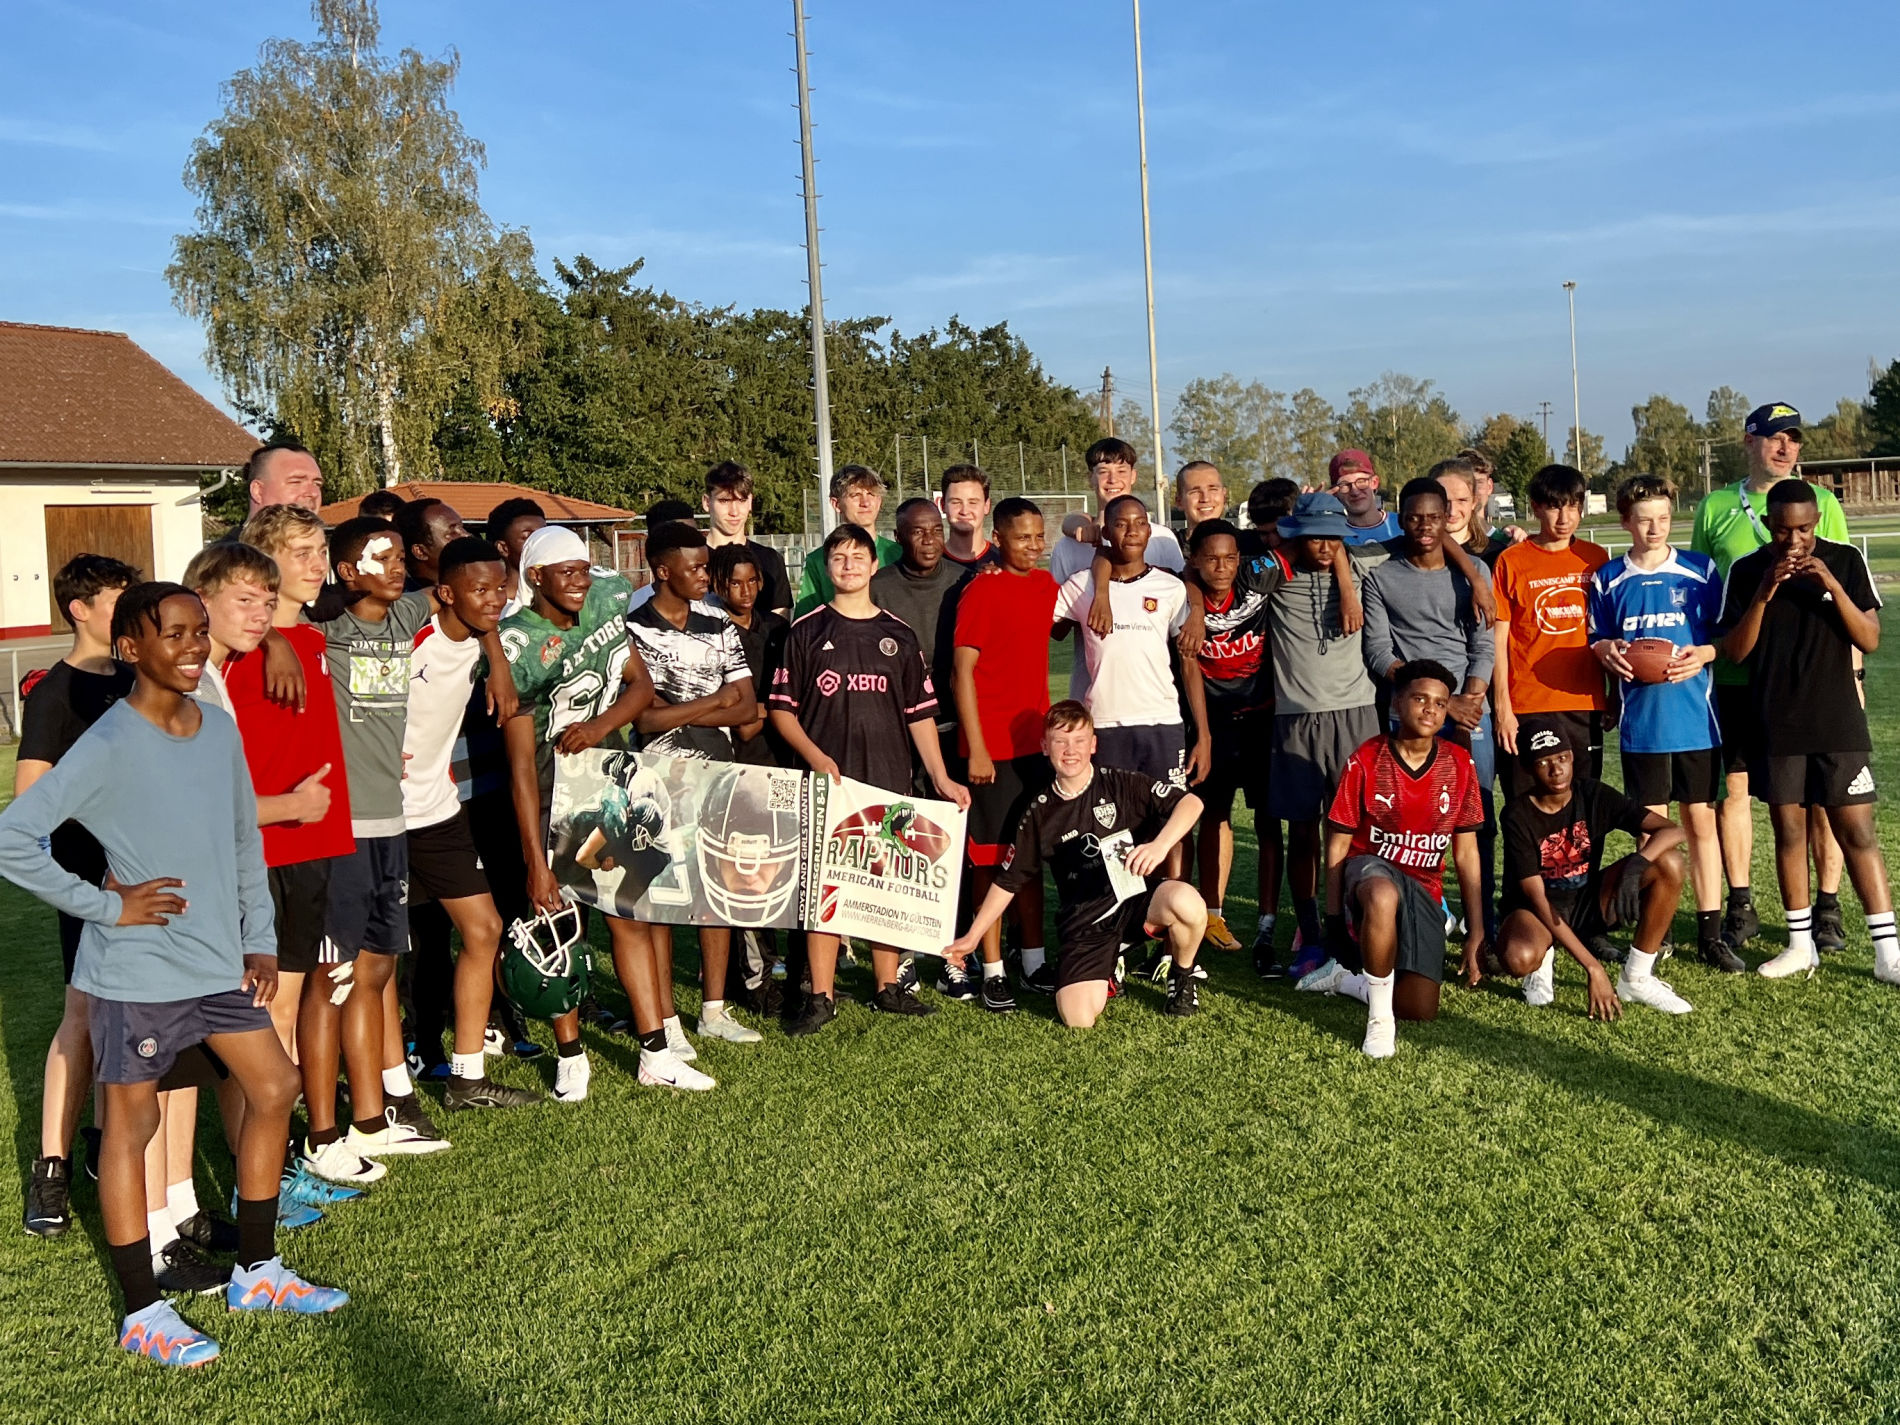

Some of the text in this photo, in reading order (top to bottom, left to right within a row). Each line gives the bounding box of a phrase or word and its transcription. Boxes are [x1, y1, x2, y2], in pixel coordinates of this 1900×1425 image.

[1528, 576, 1576, 589] TENNISCAMP
[846, 673, 887, 693] XBTO
[801, 777, 809, 826] WANTED
[808, 777, 826, 923] ALTERSGRUPPEN 8-18
[825, 835, 949, 890] RAPTORS
[1377, 842, 1441, 868] FLY BETTER
[800, 862, 808, 888] AND
[826, 869, 940, 903] AMERICAN FOOTBALL
[798, 889, 807, 921] BOYS
[843, 898, 900, 920] AMMERSTADION
[900, 910, 910, 921] TV
